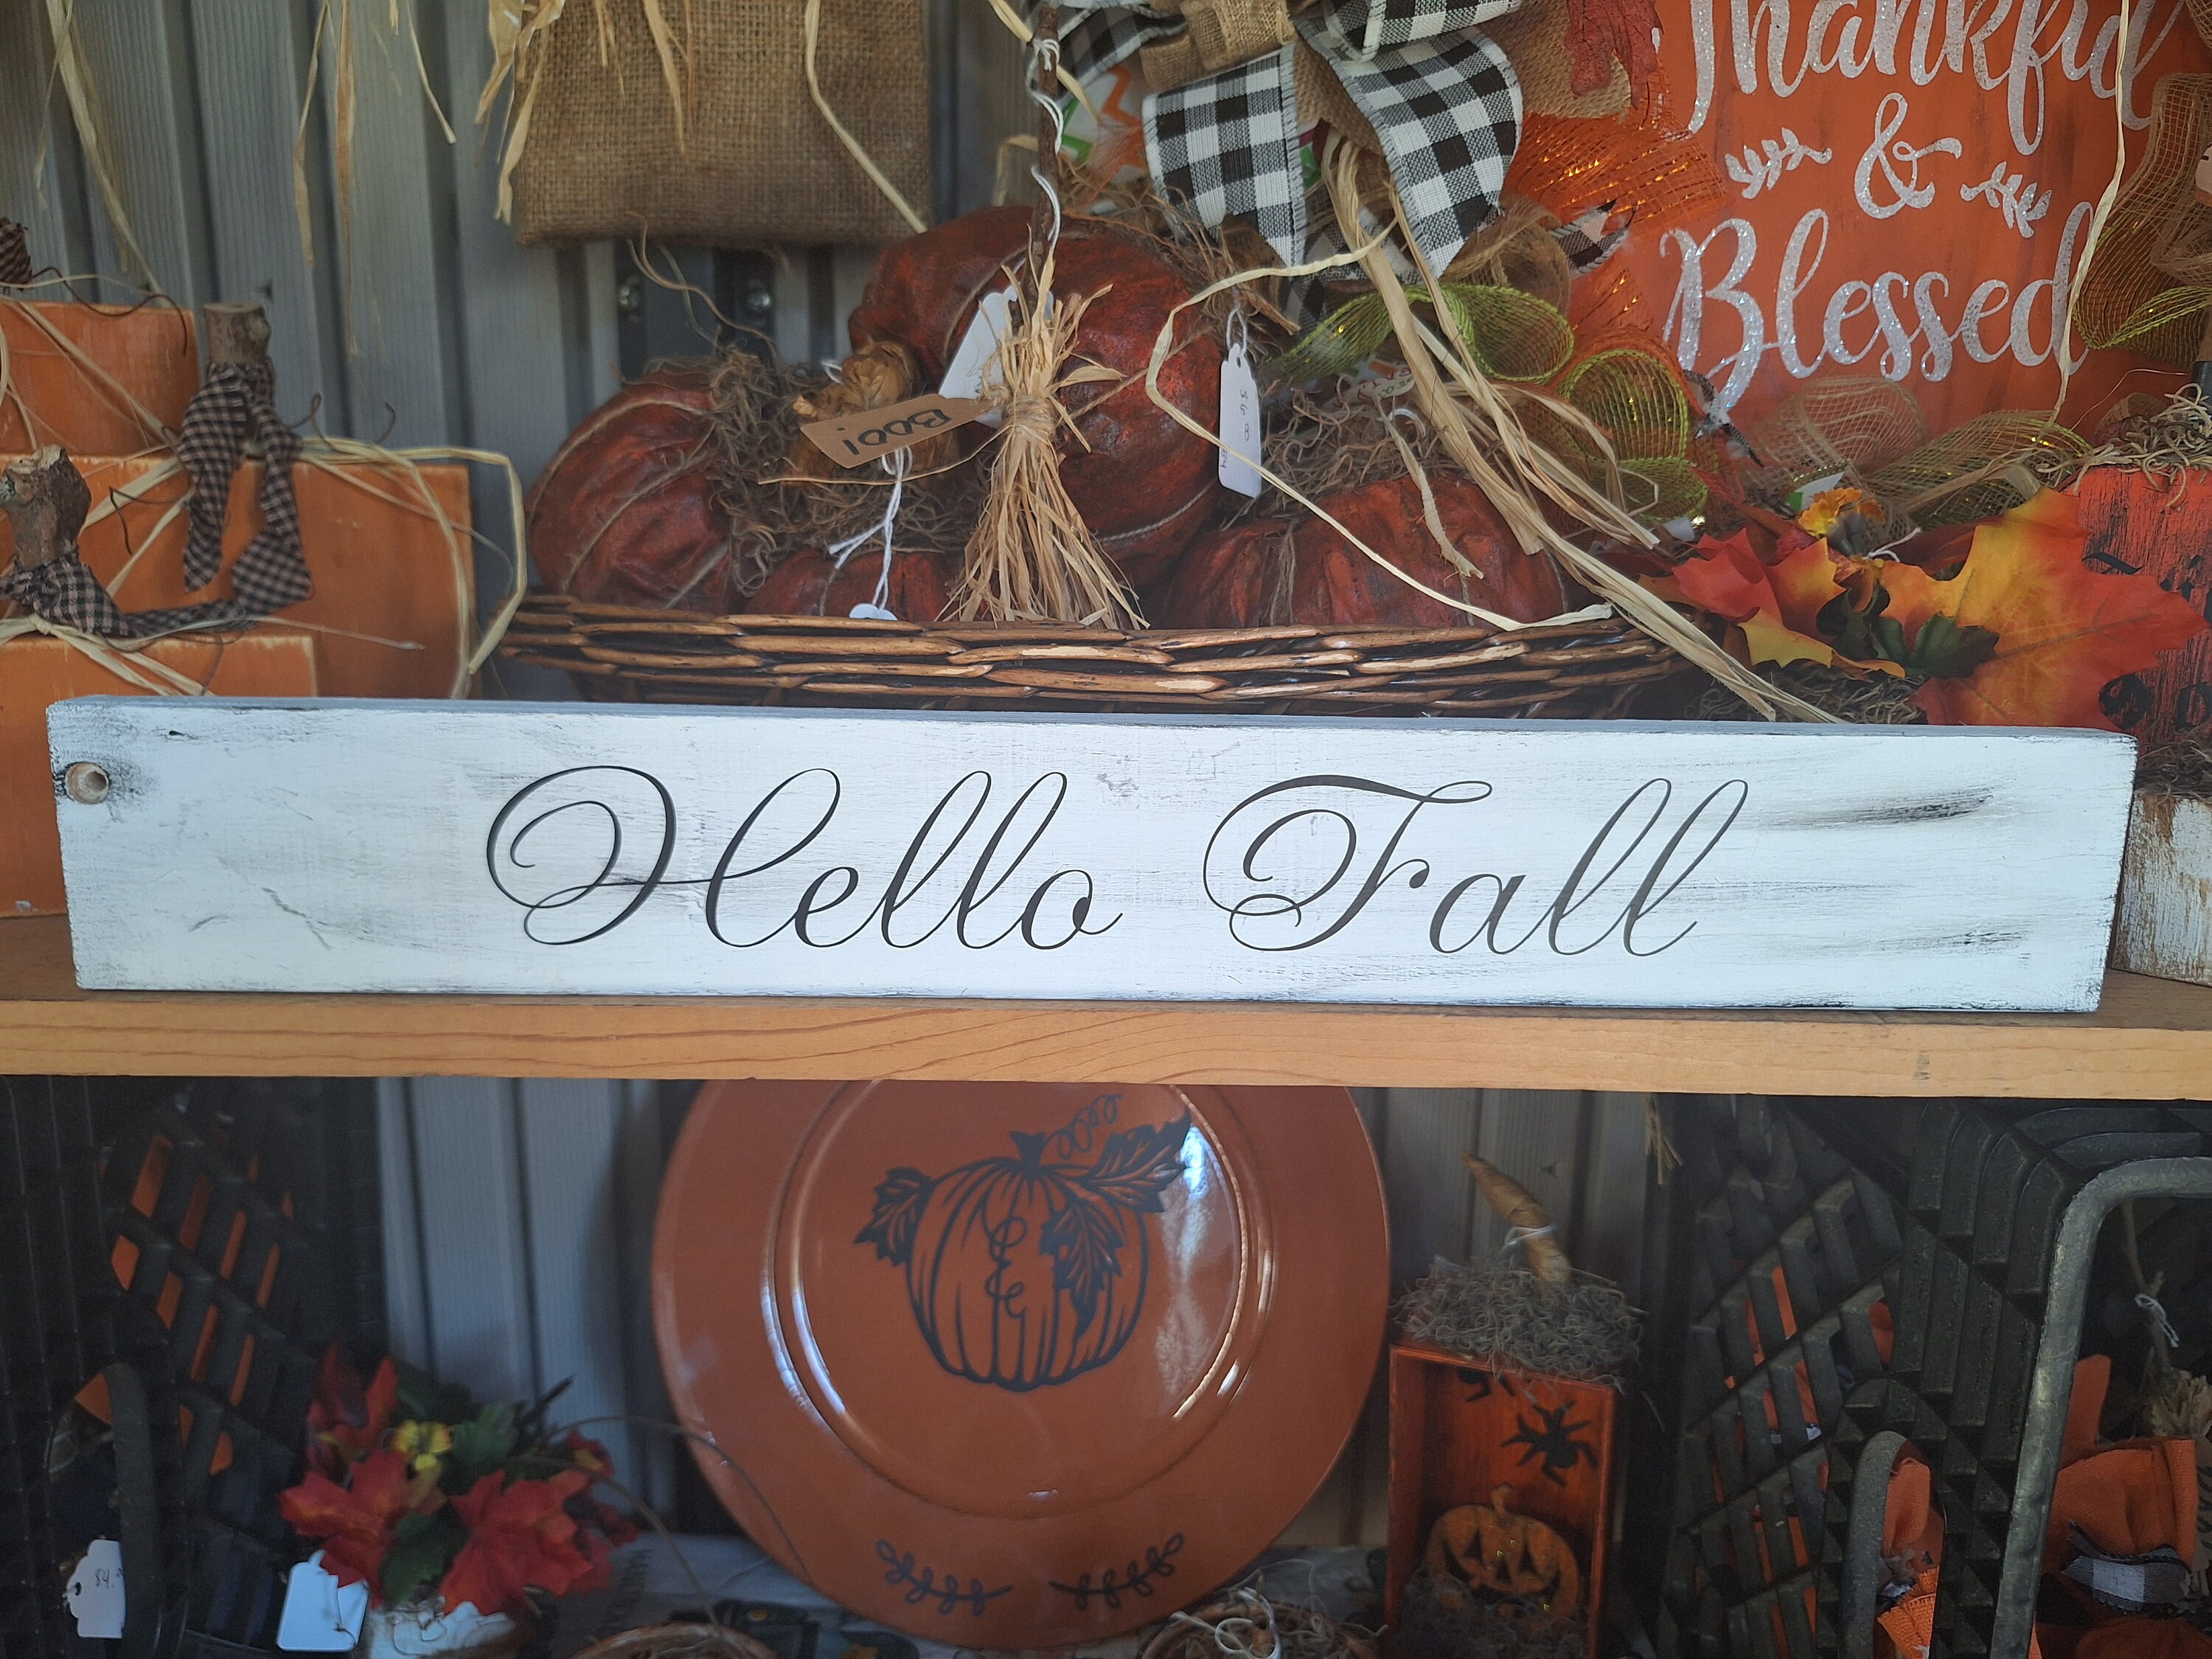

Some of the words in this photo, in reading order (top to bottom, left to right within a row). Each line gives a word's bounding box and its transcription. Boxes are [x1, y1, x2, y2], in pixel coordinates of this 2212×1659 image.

[1854, 92, 1963, 219] &
[1659, 201, 2096, 413] Blessed
[486, 765, 1124, 949] Hello
[1203, 774, 1748, 956] Fall
